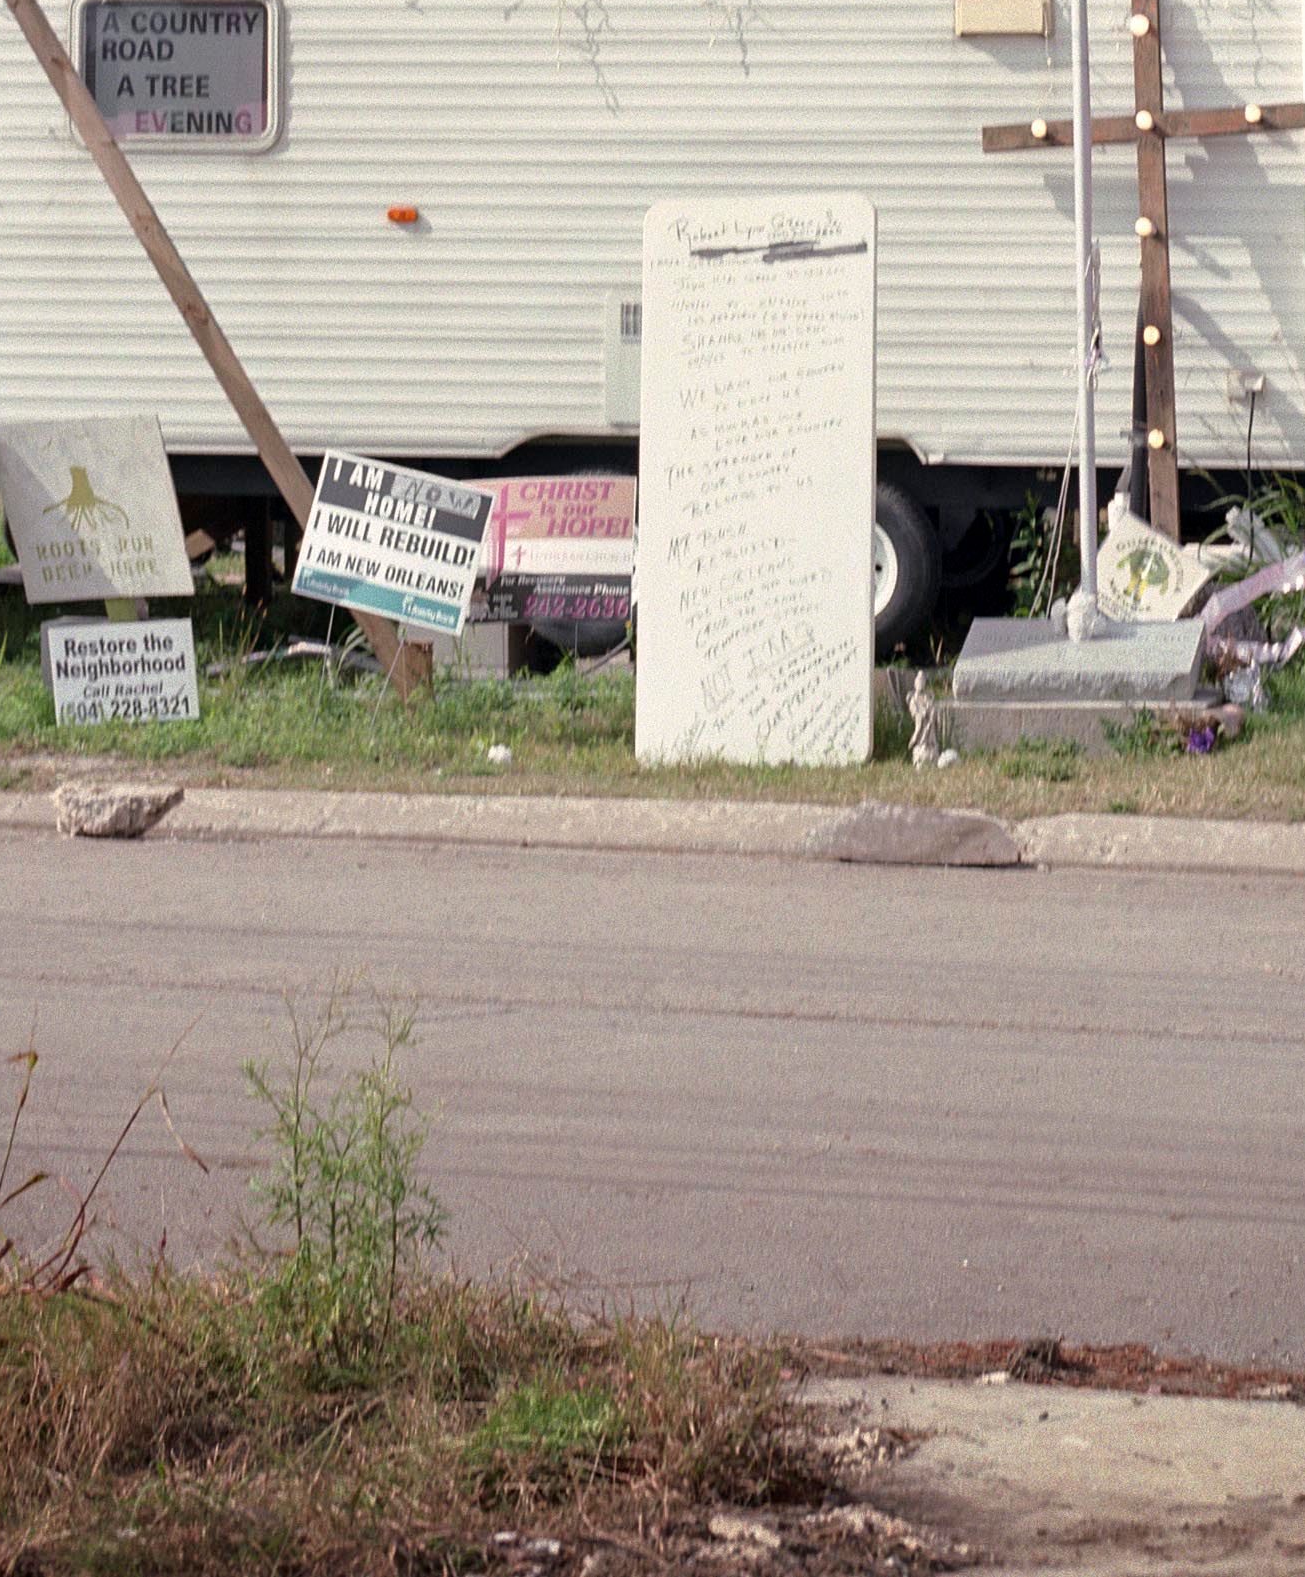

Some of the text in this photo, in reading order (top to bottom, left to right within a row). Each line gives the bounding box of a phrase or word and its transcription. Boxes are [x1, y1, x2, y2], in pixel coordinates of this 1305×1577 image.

[102, 12, 259, 35] A COUNTRY
[102, 39, 174, 62] ROAD
[117, 75, 210, 98] A TREE
[135, 111, 252, 135] EVENING
[333, 459, 475, 509] I AM NOW
[519, 480, 615, 501] CHRIST
[364, 491, 437, 529] HOME!
[563, 504, 597, 516] our
[547, 517, 630, 537] HOPE!
[313, 509, 477, 569] I WILL REBUILD!
[306, 546, 465, 600] I AM NEW ORLEANS!
[518, 575, 566, 588] Recovery
[533, 583, 630, 596] Assistance Phone
[64, 633, 173, 657] Restore the
[56, 652, 186, 681] Neighborhood
[83, 680, 163, 699] Call Rachel
[111, 694, 191, 720] 228-8321
